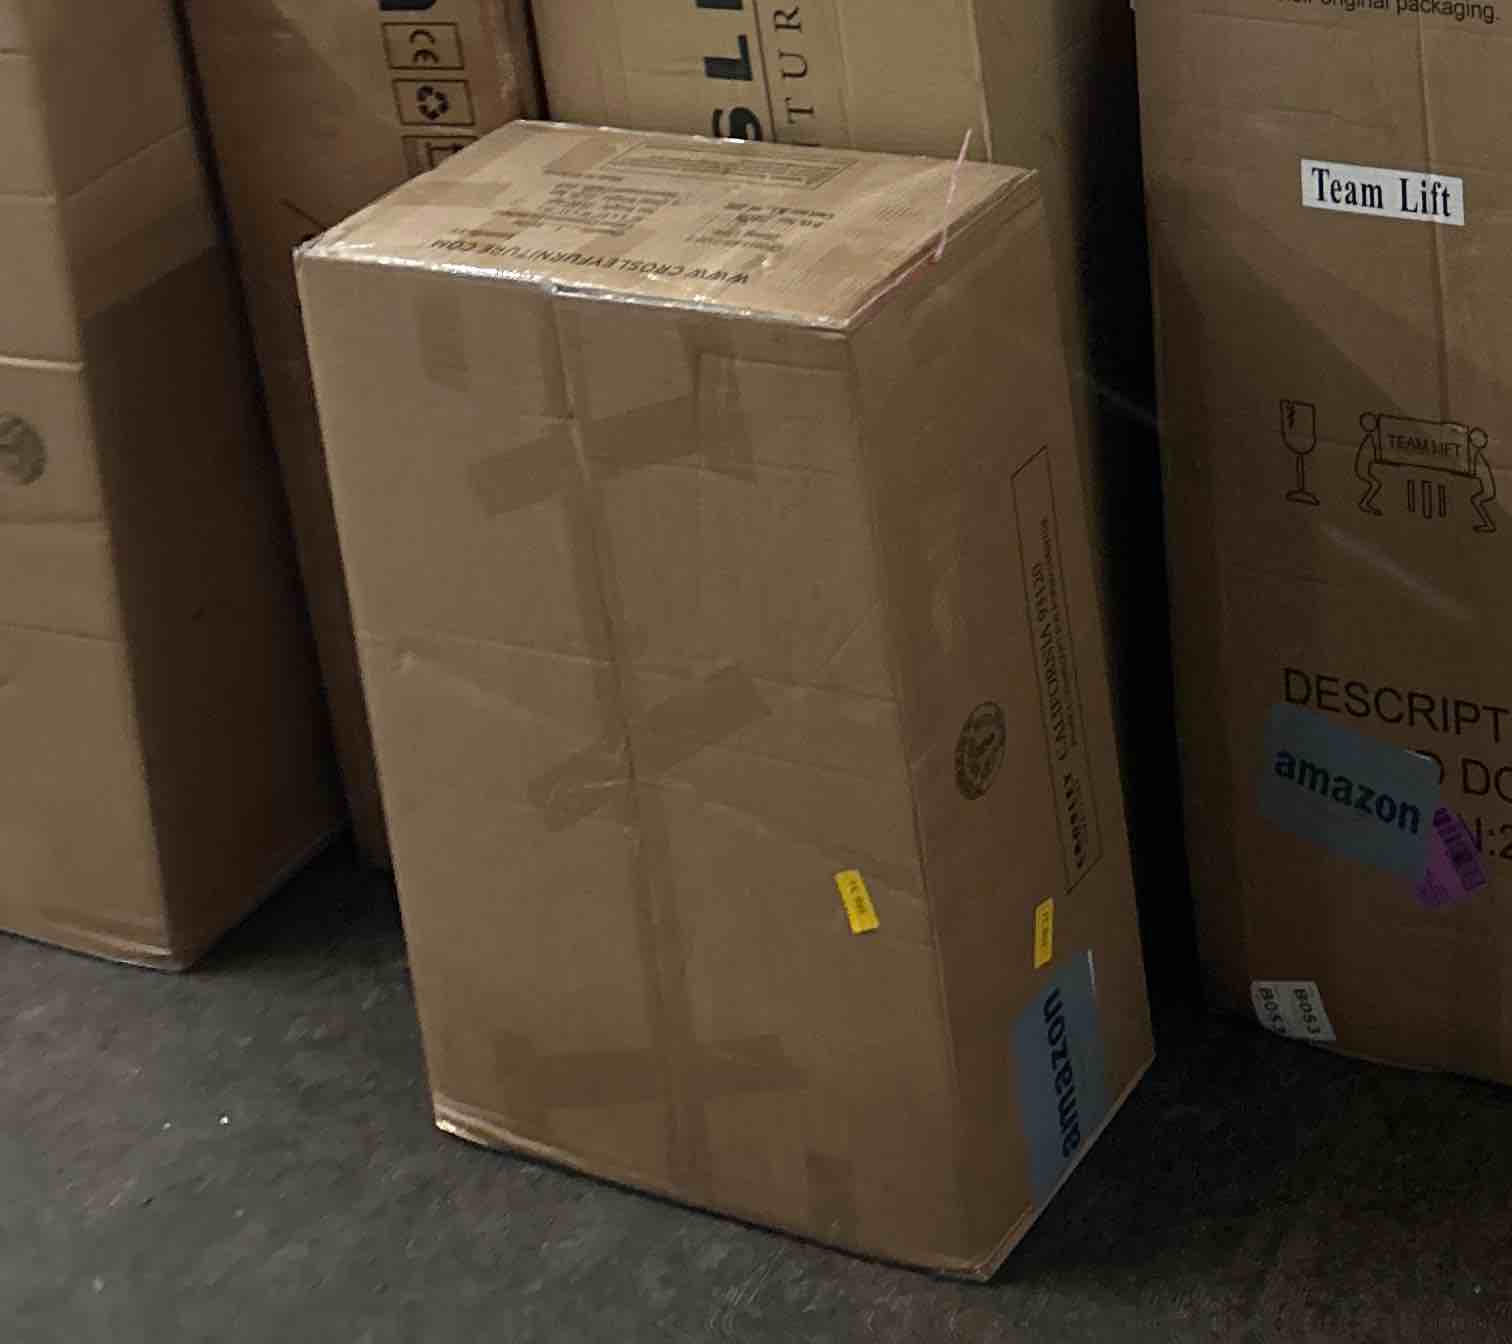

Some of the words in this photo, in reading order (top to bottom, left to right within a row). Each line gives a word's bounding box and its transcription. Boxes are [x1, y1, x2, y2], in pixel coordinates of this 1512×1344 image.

[1312, 168, 1384, 210] Team
[1400, 178, 1451, 217] Lift
[1274, 750, 1422, 836] amazon
[1044, 988, 1082, 1160] amazon
